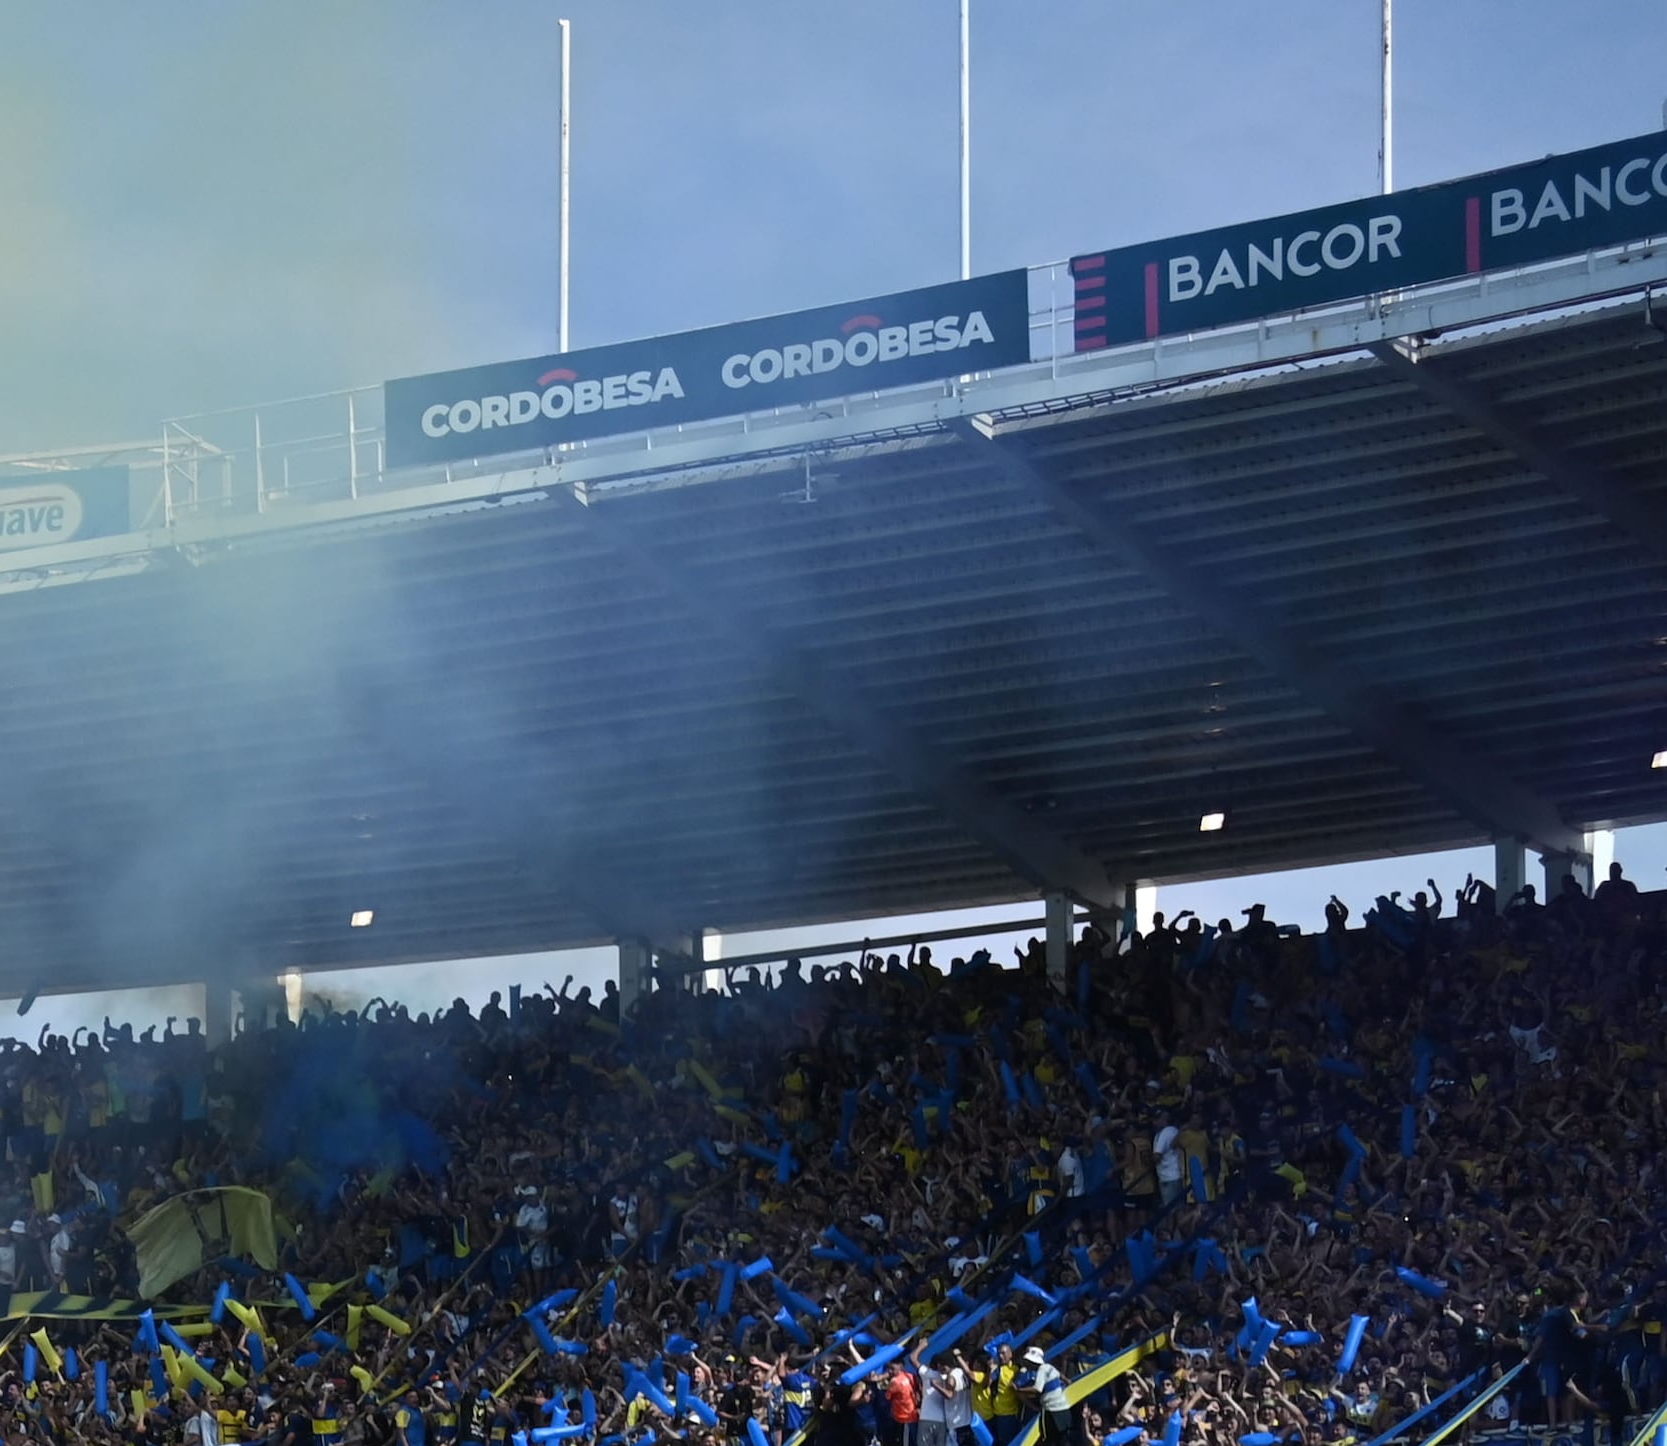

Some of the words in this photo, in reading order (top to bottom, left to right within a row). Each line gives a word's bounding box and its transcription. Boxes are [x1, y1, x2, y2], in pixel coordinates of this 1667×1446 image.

[1167, 214, 1403, 304] BANCOR
[721, 309, 995, 392] CORDOBESA
[421, 365, 685, 439] CORDOBESA
